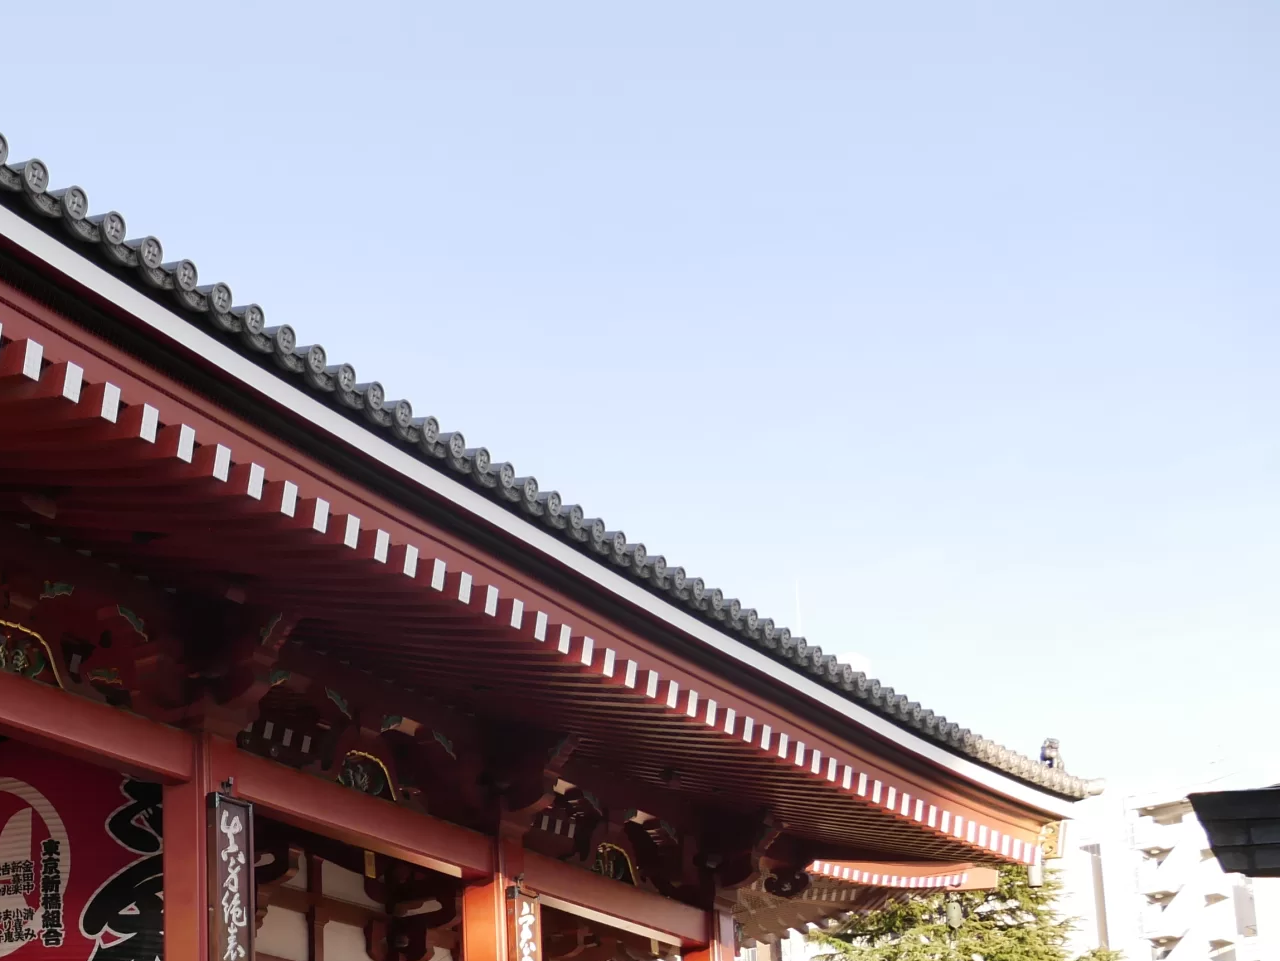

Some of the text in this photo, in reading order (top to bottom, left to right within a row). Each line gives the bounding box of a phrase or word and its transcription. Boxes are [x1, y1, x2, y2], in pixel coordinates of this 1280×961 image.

[41, 838, 63, 947] 東京新橋組合
